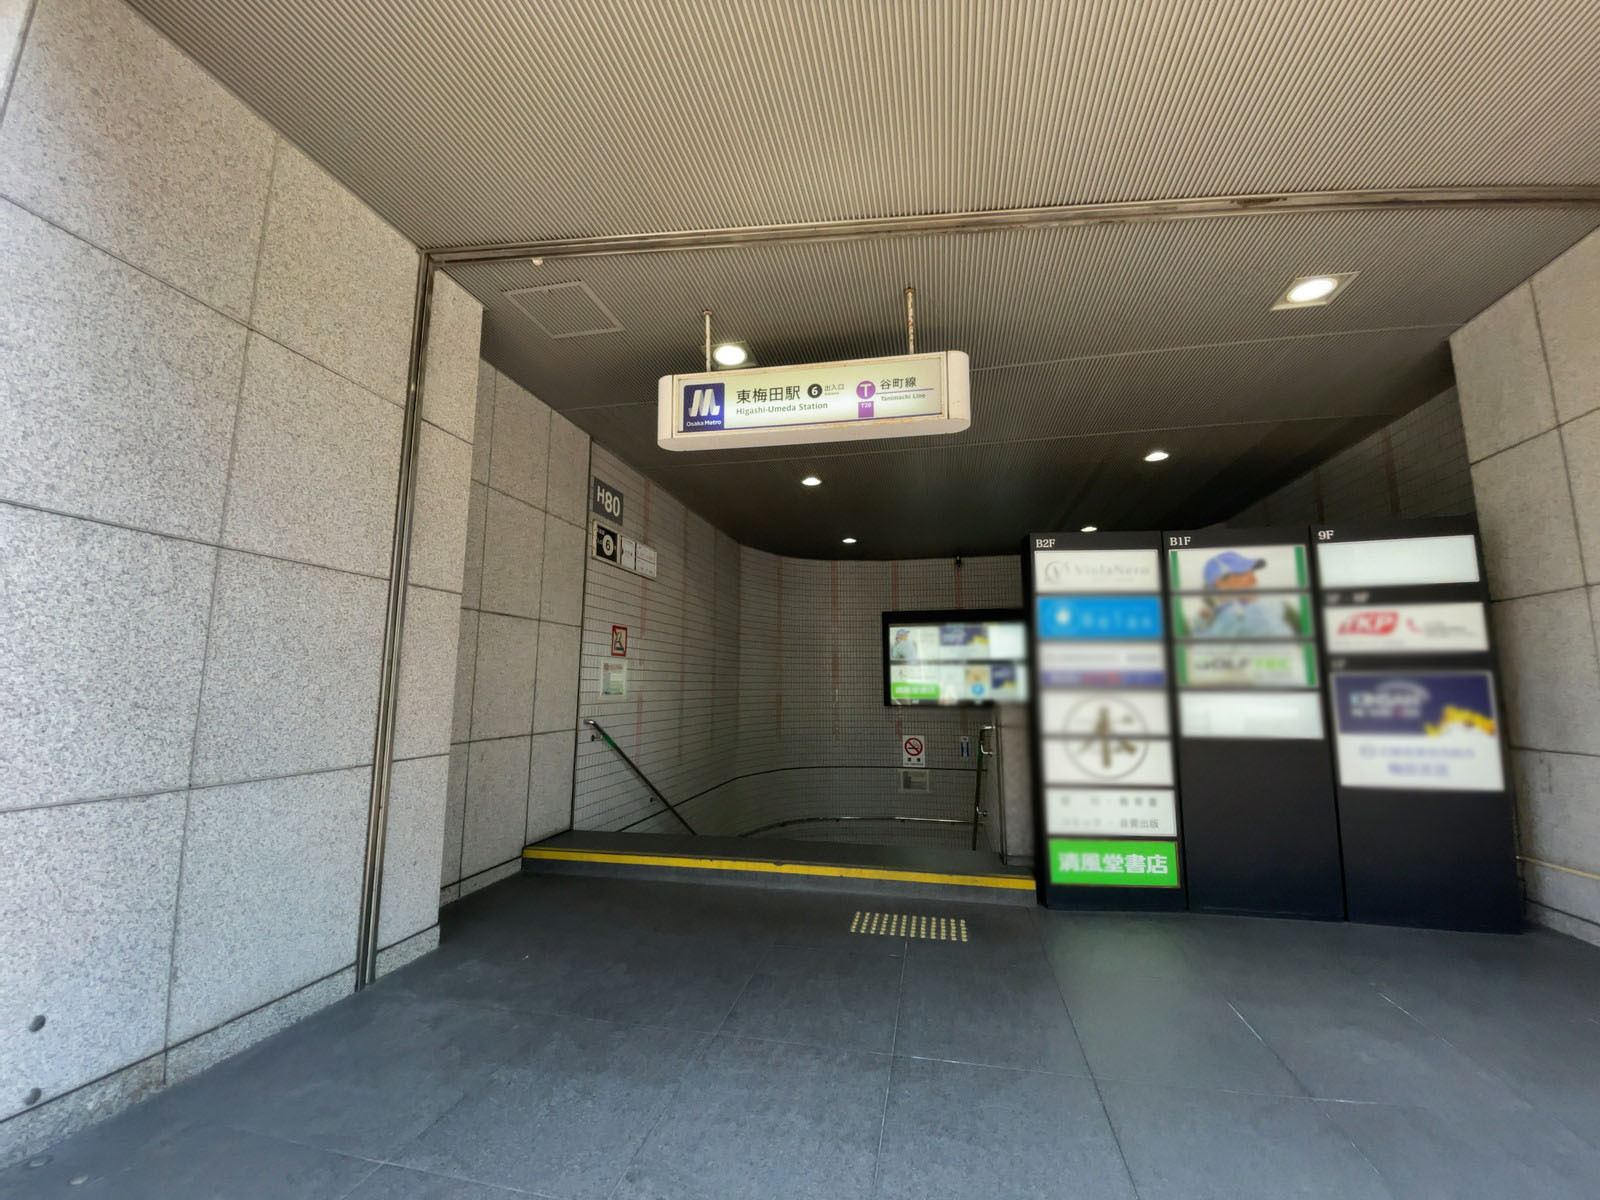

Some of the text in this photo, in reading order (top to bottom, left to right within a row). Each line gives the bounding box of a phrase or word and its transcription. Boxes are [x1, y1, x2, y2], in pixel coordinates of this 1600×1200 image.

[824, 383, 844, 392] 出入口
[880, 376, 916, 390] 谷町線
[736, 385, 800, 404] 東梅田駅
[736, 402, 828, 416] Higashi-Umeda Station
[597, 485, 620, 517] H80
[1169, 536, 1191, 547] B1F
[1318, 529, 1334, 541] 9F
[1035, 538, 1056, 549] B2F
